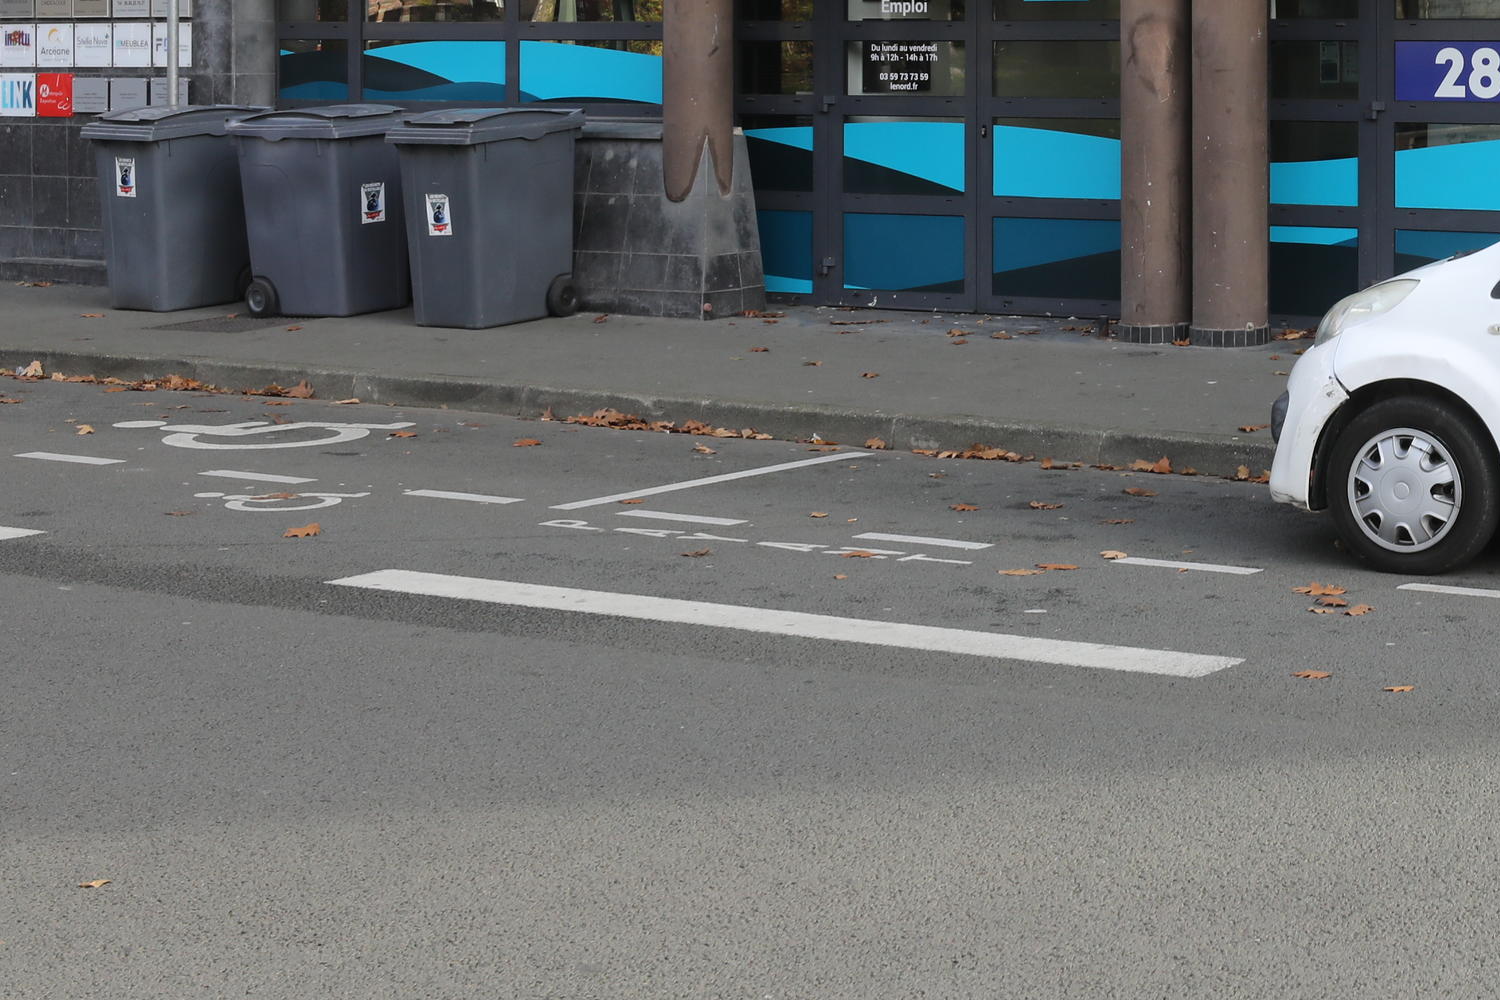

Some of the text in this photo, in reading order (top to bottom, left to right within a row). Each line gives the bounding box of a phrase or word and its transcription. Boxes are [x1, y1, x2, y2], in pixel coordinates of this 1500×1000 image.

[871, 43, 881, 52] Du
[881, 43, 899, 52] lundi
[909, 43, 938, 52] vendredi
[870, 53, 880, 62] 9h
[880, 53, 886, 62] à
[886, 53, 899, 62] 12h
[905, 53, 918, 62] 14h
[918, 53, 924, 62] à
[925, 53, 938, 62] 17h
[879, 72, 929, 81] 03 59 73 73 59
[889, 81, 919, 91] lenord.fr
